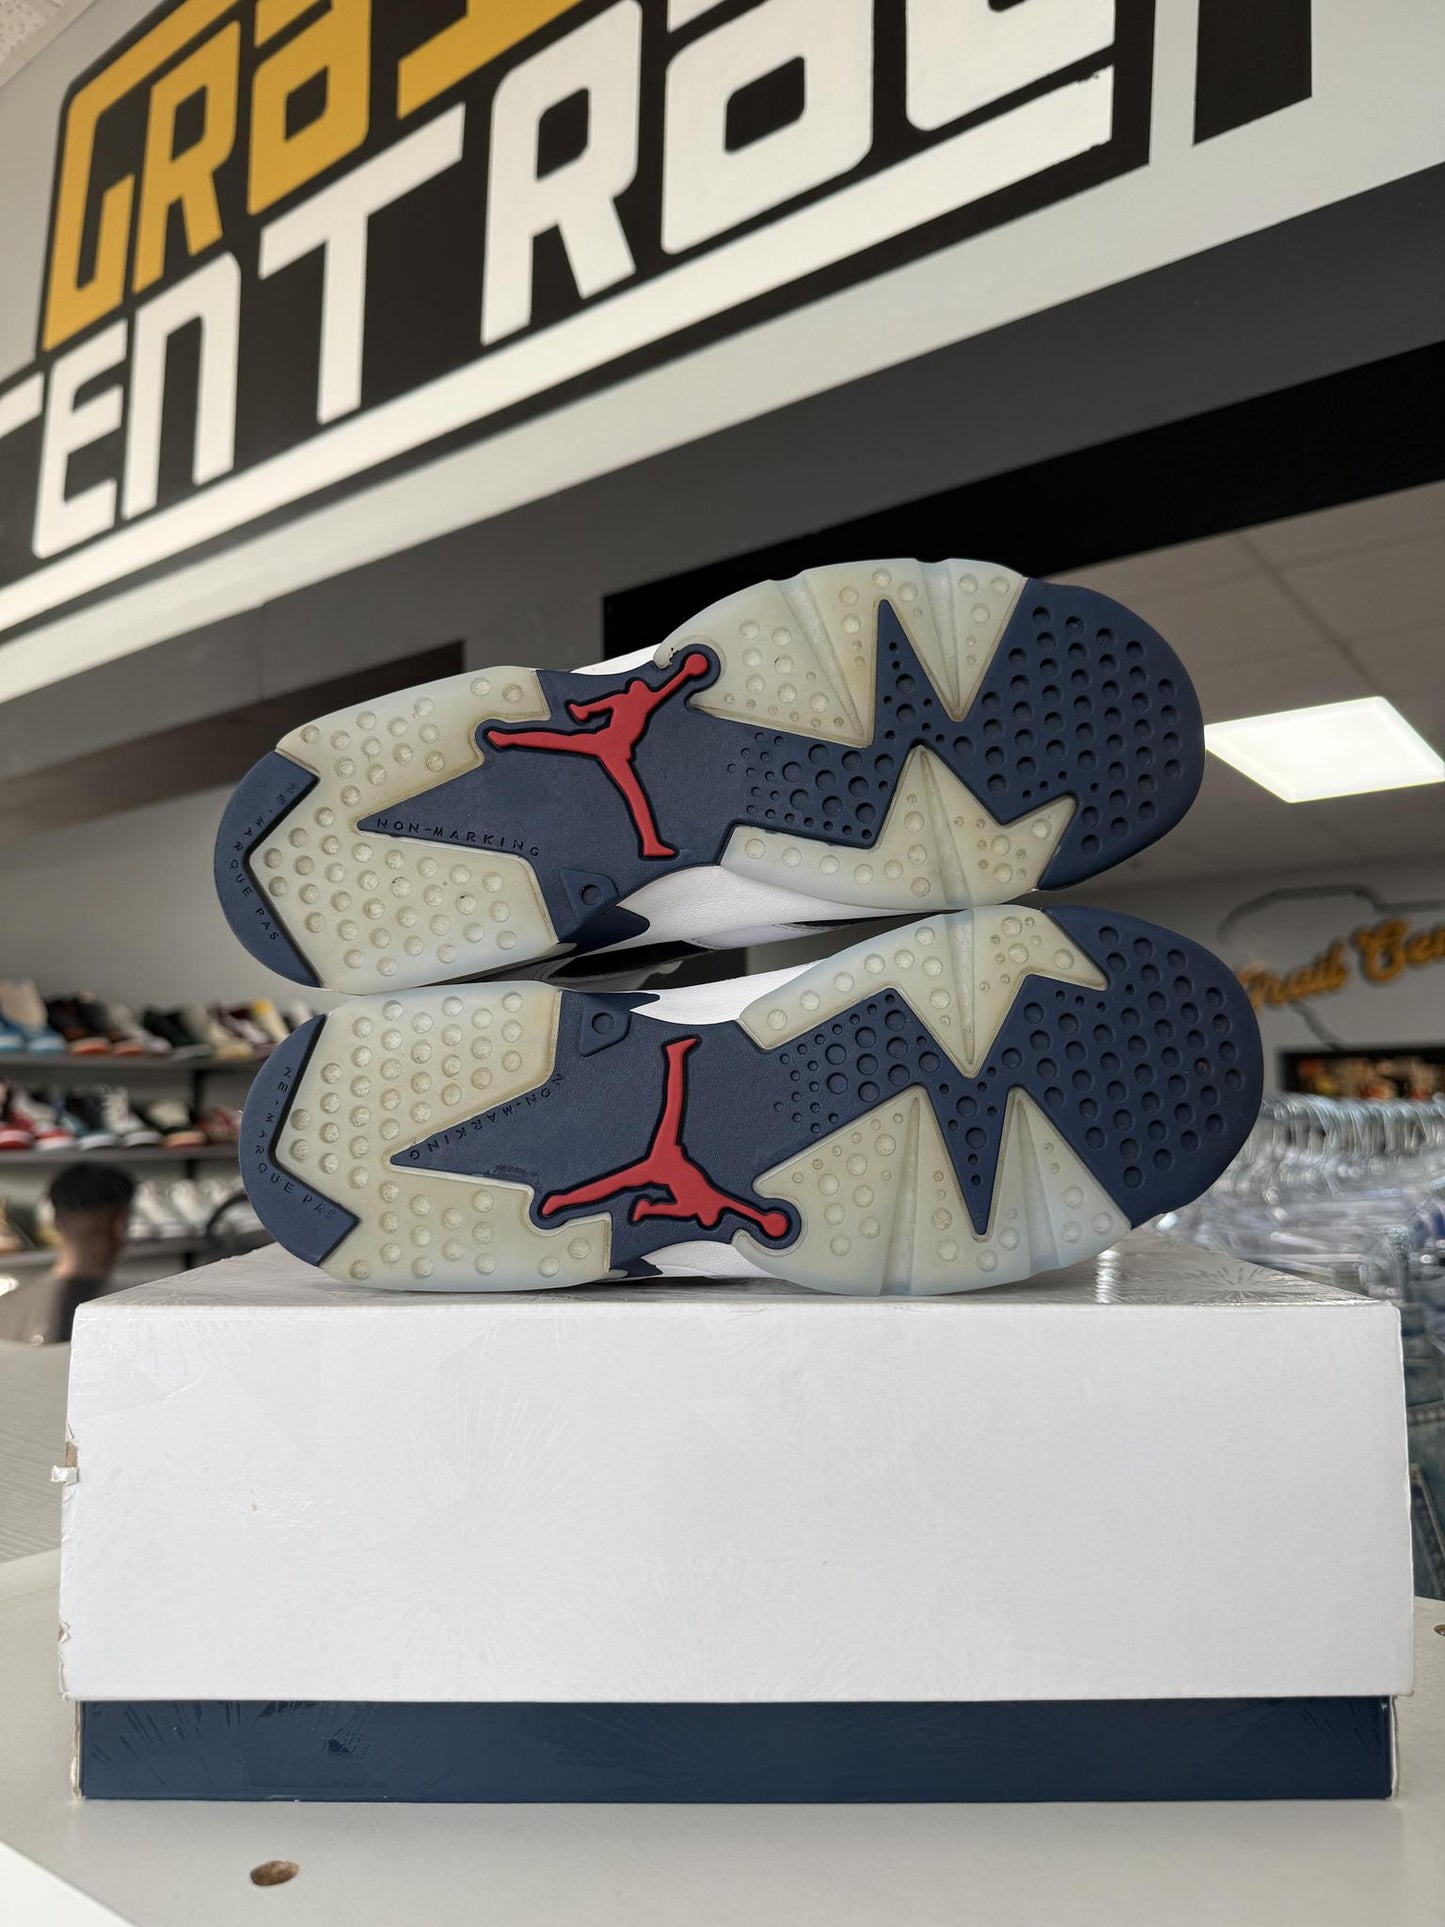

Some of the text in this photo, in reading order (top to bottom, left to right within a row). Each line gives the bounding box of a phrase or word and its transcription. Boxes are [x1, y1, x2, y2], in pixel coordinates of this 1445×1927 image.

[376, 817, 541, 857] NON-MARKING
[255, 906, 280, 941] PAS
[408, 1071, 566, 1161] NON-MARKING
[302, 1193, 337, 1219] PAS
